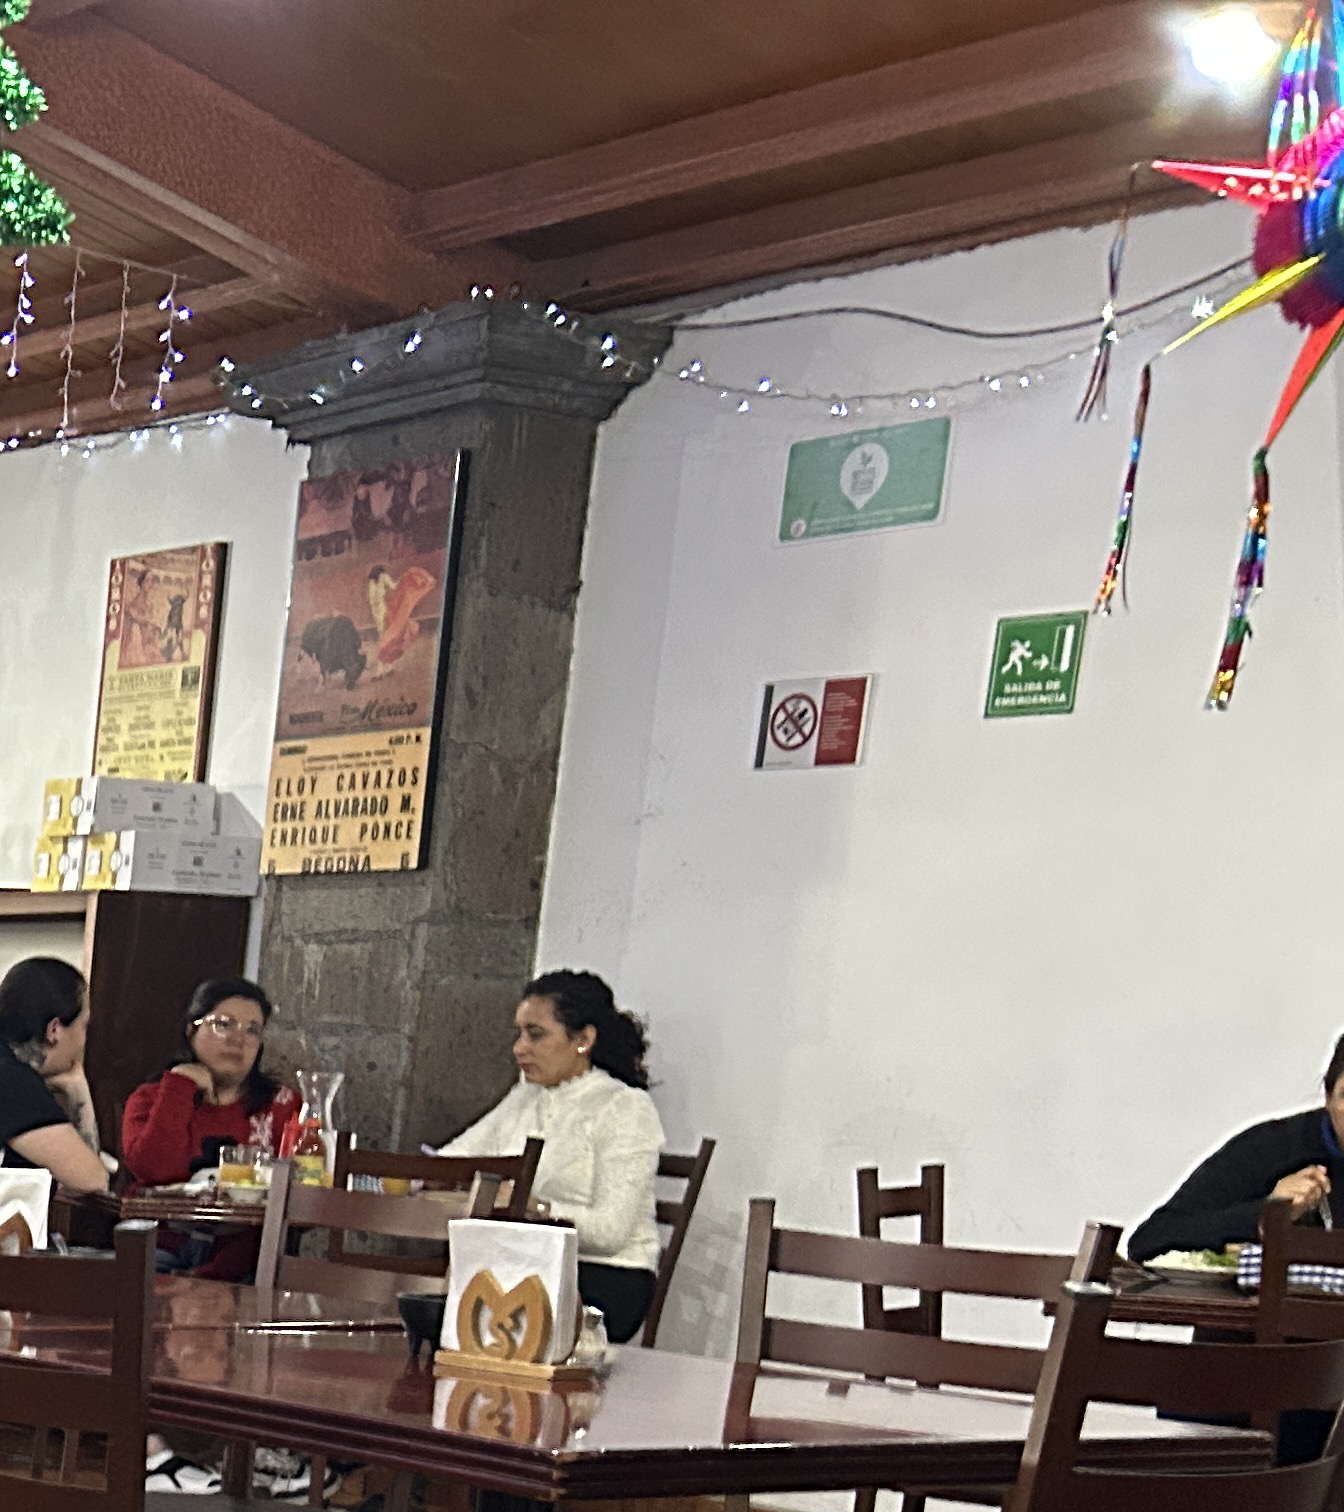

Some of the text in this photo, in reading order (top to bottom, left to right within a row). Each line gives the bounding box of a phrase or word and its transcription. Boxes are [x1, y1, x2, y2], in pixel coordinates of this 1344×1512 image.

[995, 692, 1067, 706] EMERGENCIA
[1004, 679, 1061, 693] SALIDA DE
[275, 775, 317, 798] ELOY
[336, 766, 420, 792] CAVAZOS
[315, 794, 389, 820] ALVARADO
[400, 793, 416, 815] M.
[270, 820, 414, 848] ENRIQUE PONCE
